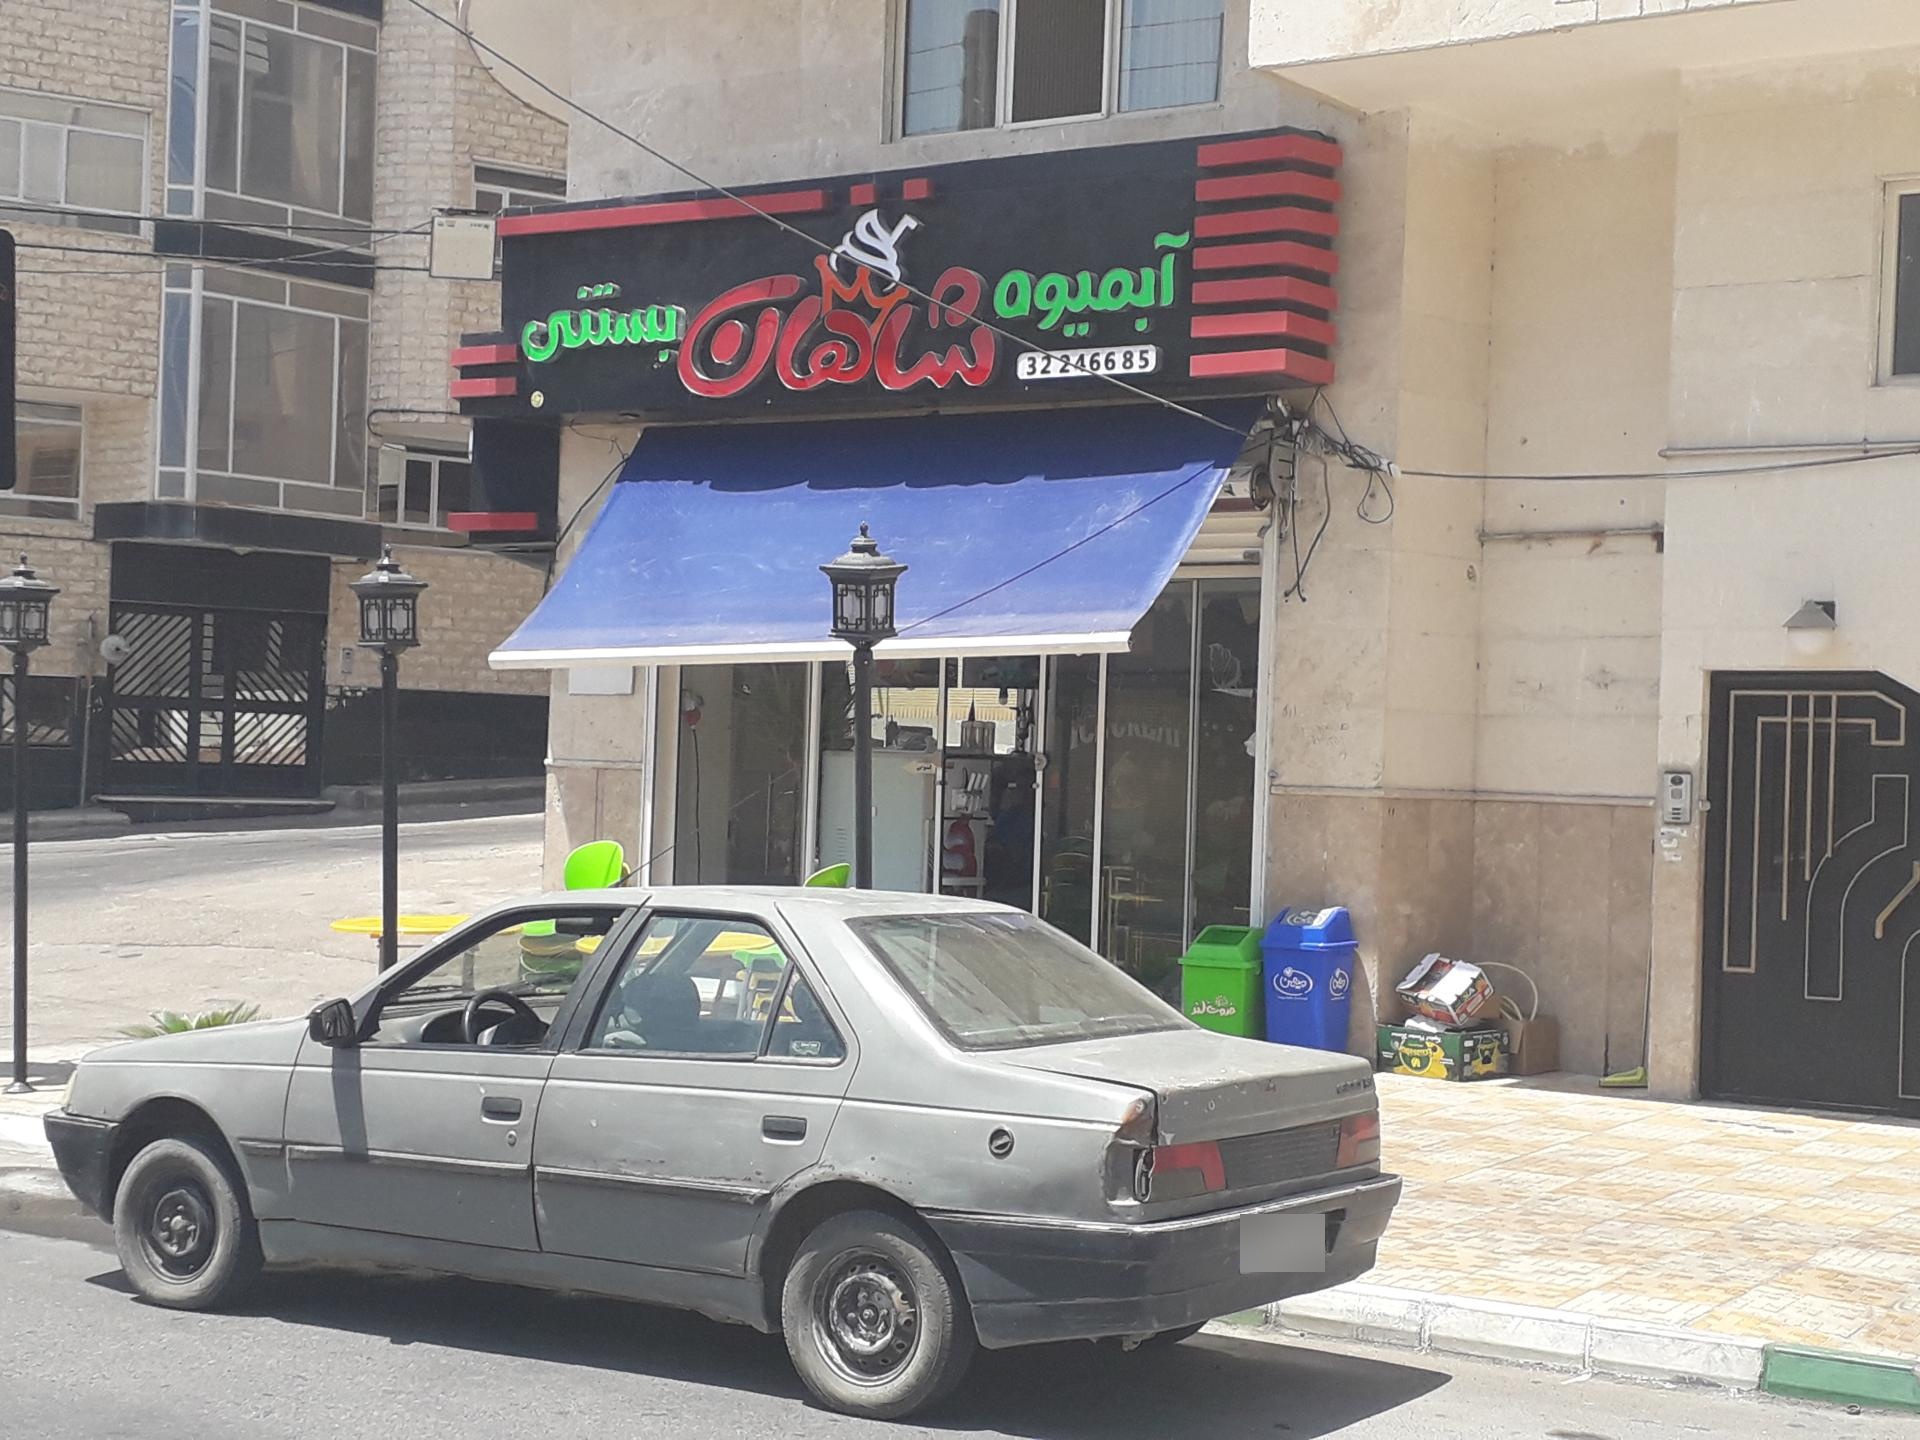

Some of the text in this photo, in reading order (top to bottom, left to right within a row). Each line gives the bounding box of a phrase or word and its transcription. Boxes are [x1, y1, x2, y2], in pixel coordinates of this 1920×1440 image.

[522, 231, 1190, 398] آبمیوه شاهان بستنی
[1026, 349, 1150, 377] 32246685
